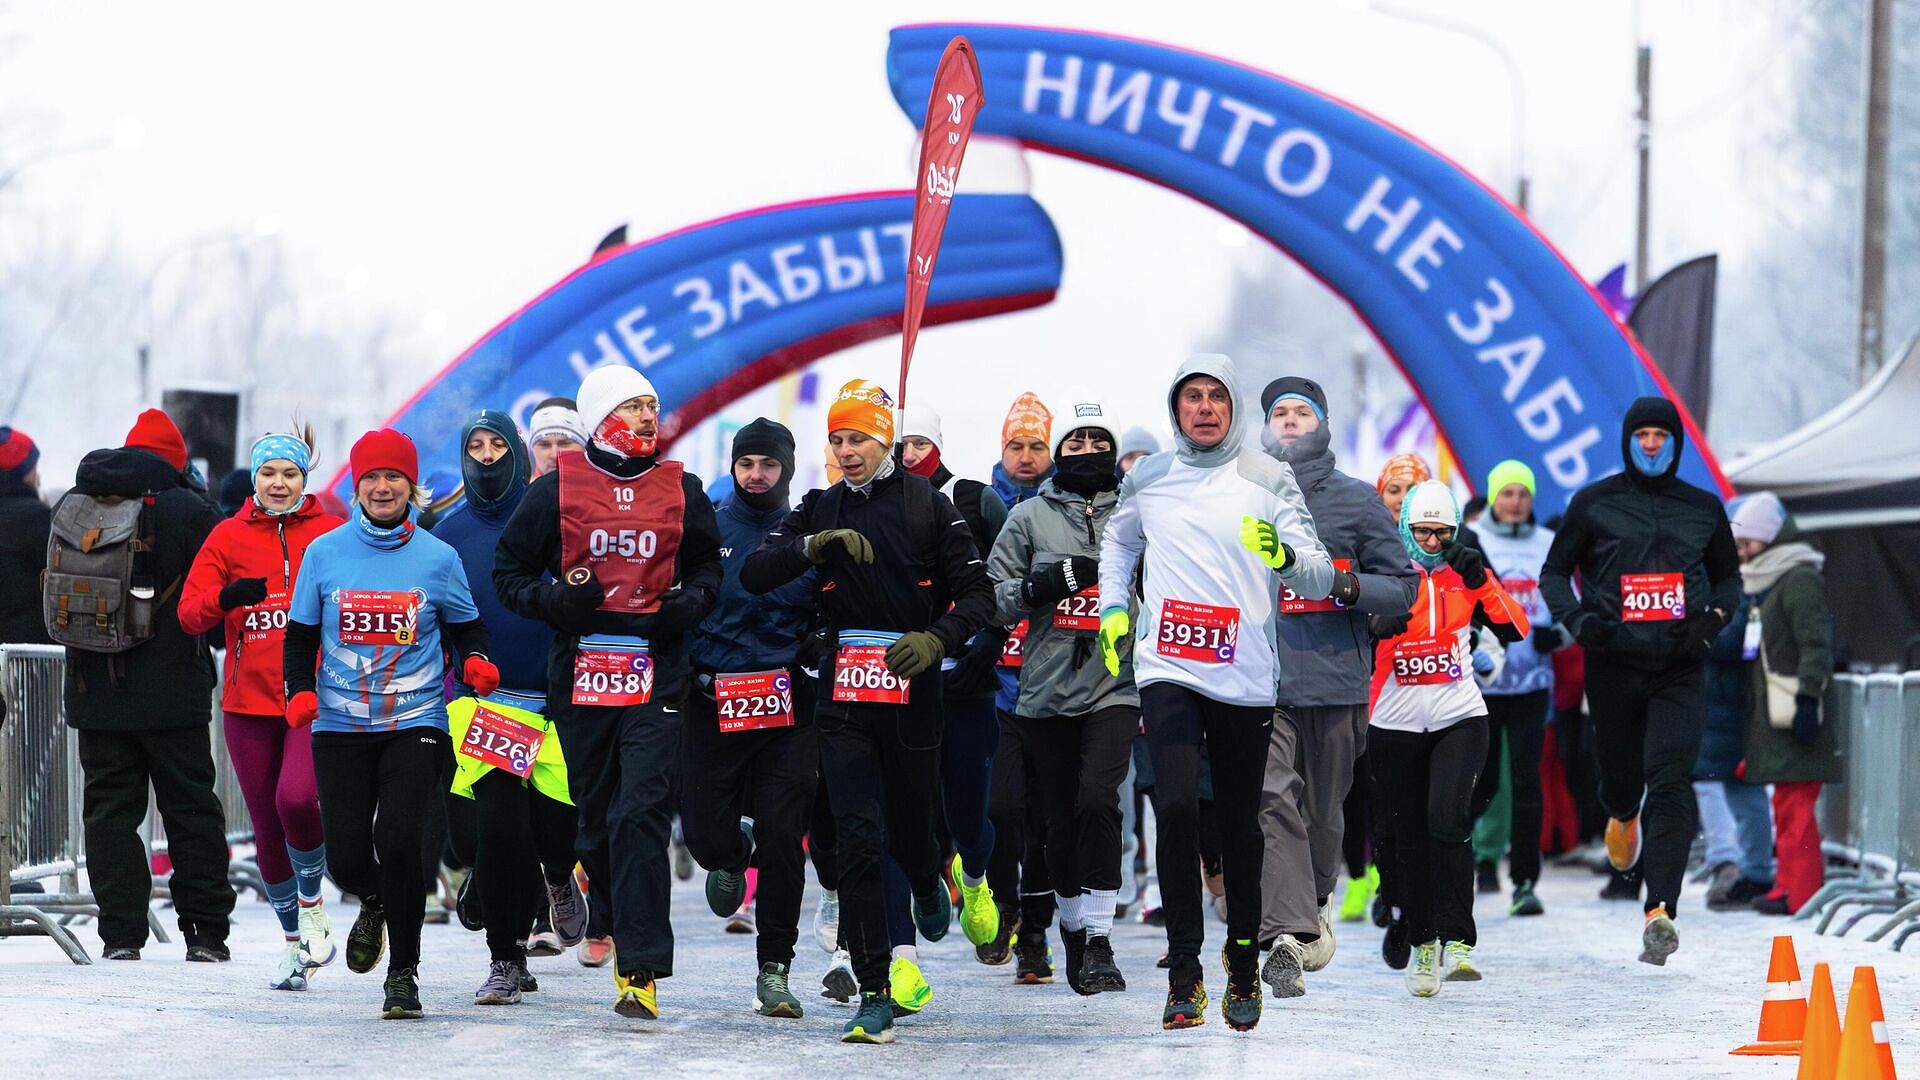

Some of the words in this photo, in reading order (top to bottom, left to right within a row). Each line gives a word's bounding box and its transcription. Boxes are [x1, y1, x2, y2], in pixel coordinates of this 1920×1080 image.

[1022, 51, 1332, 199] НИЧТО
[1345, 174, 1465, 293] НЕ
[569, 305, 674, 383] НЕ
[613, 487, 634, 503] 10
[589, 529, 657, 558] 0:50
[1062, 557, 1079, 592] PIONEER
[1623, 591, 1675, 610] 4016
[1671, 605, 1682, 616] C
[245, 609, 290, 631] 430
[342, 612, 404, 633] 3315
[399, 630, 409, 641] B
[1160, 621, 1220, 649] 3931
[1219, 646, 1231, 659] C
[633, 657, 645, 670] C
[1395, 653, 1450, 676] 3965
[1449, 666, 1460, 677] C
[575, 672, 640, 694] 4058
[775, 677, 787, 689] C
[836, 666, 897, 690] 4066
[720, 695, 780, 719] 4229
[466, 725, 527, 759] 3126
[473, 749, 484, 757] КМ
[513, 759, 524, 771] C
